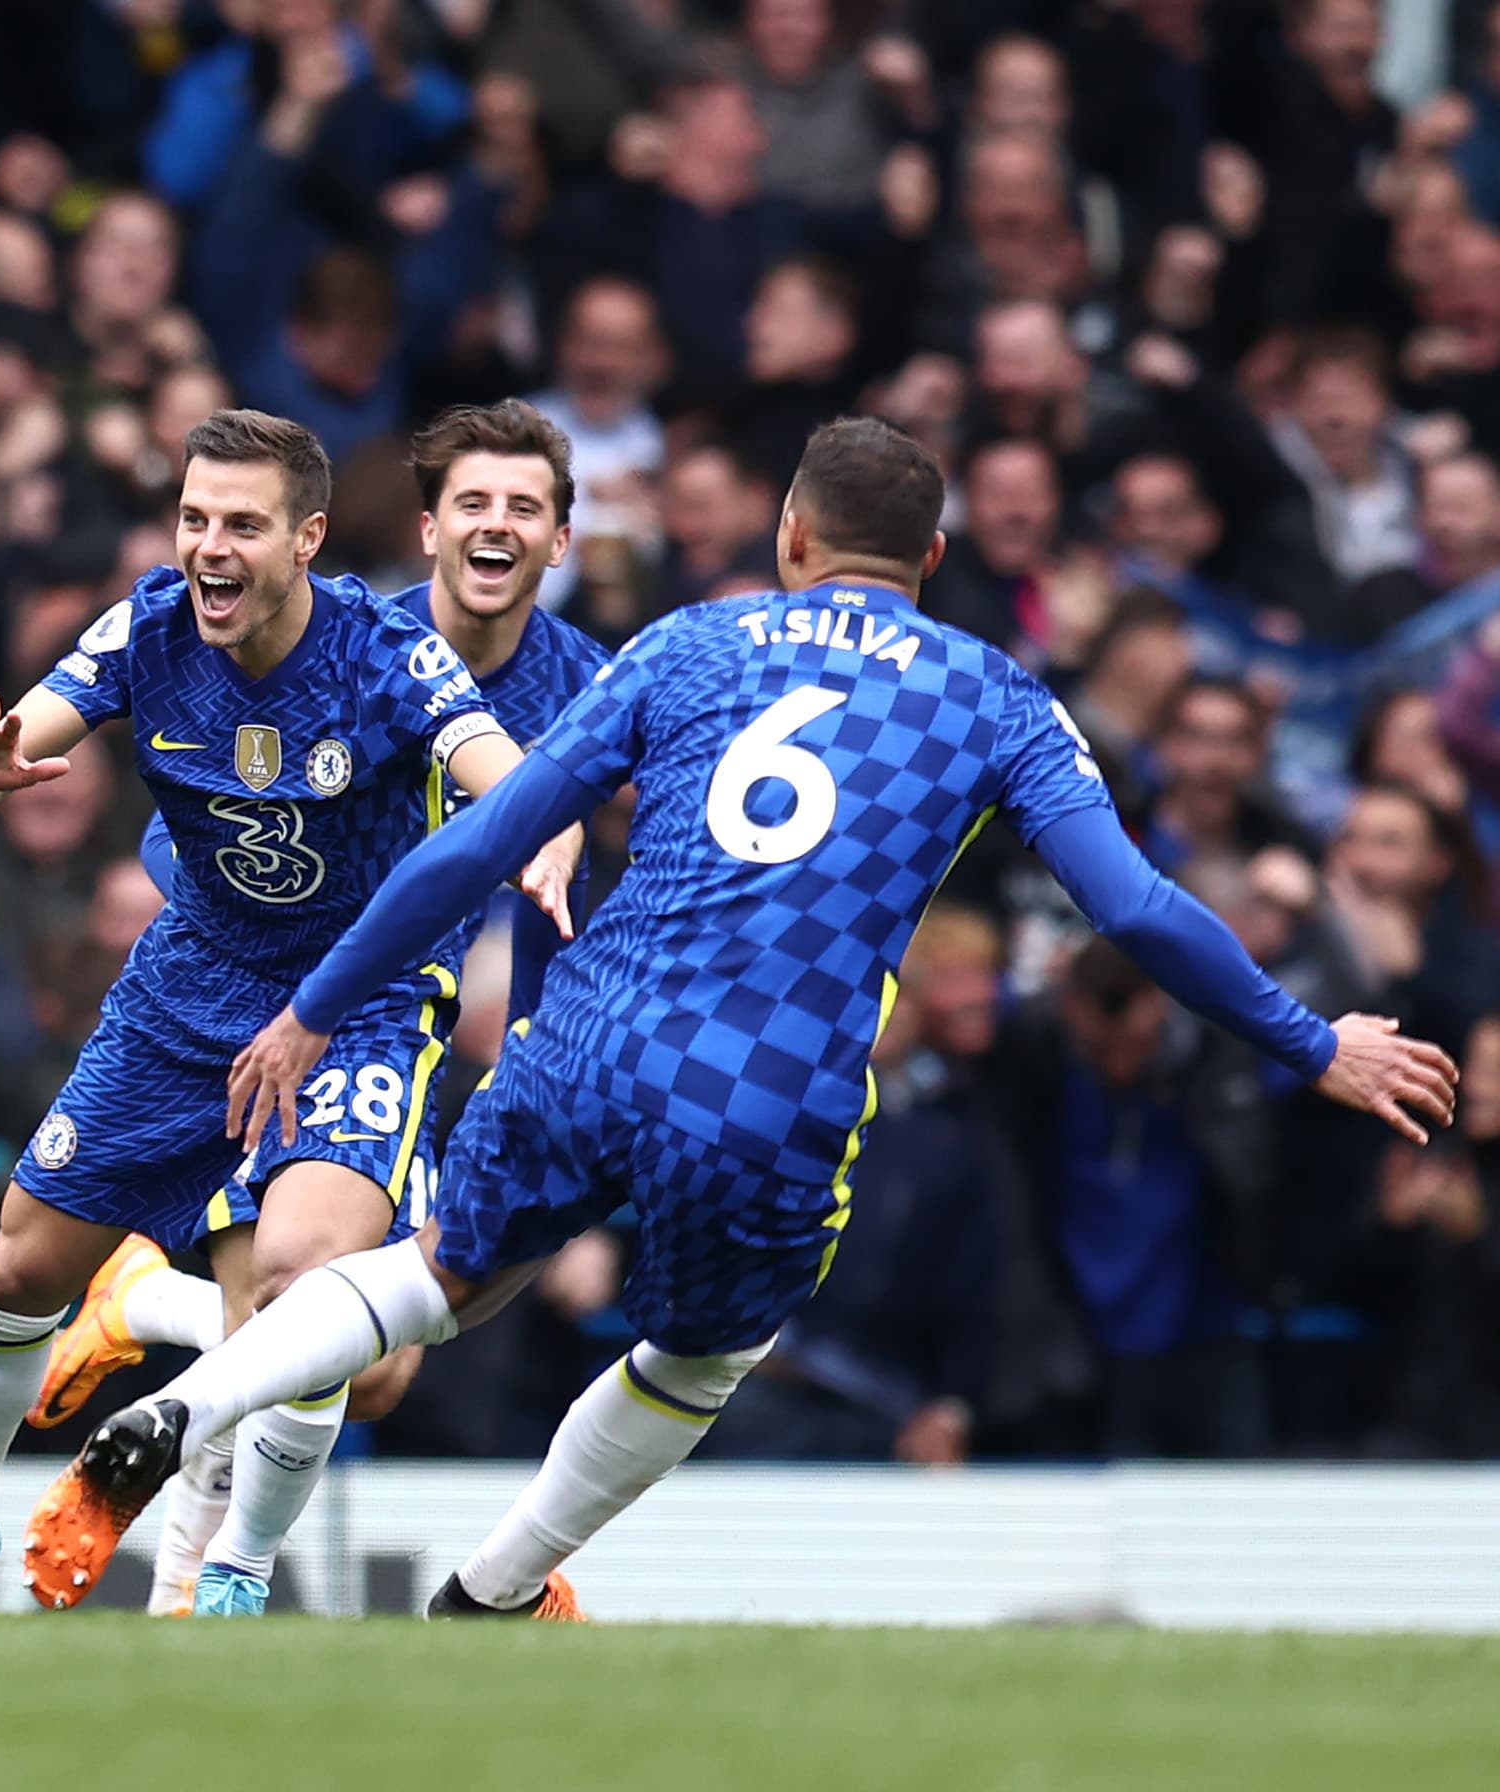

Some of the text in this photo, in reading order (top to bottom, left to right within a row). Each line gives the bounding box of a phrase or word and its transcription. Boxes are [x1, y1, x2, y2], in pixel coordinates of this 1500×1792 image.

[737, 608, 921, 672] T.SILVA
[247, 765, 269, 775] FIFA
[706, 684, 848, 864] 6
[301, 1064, 404, 1134] 28
